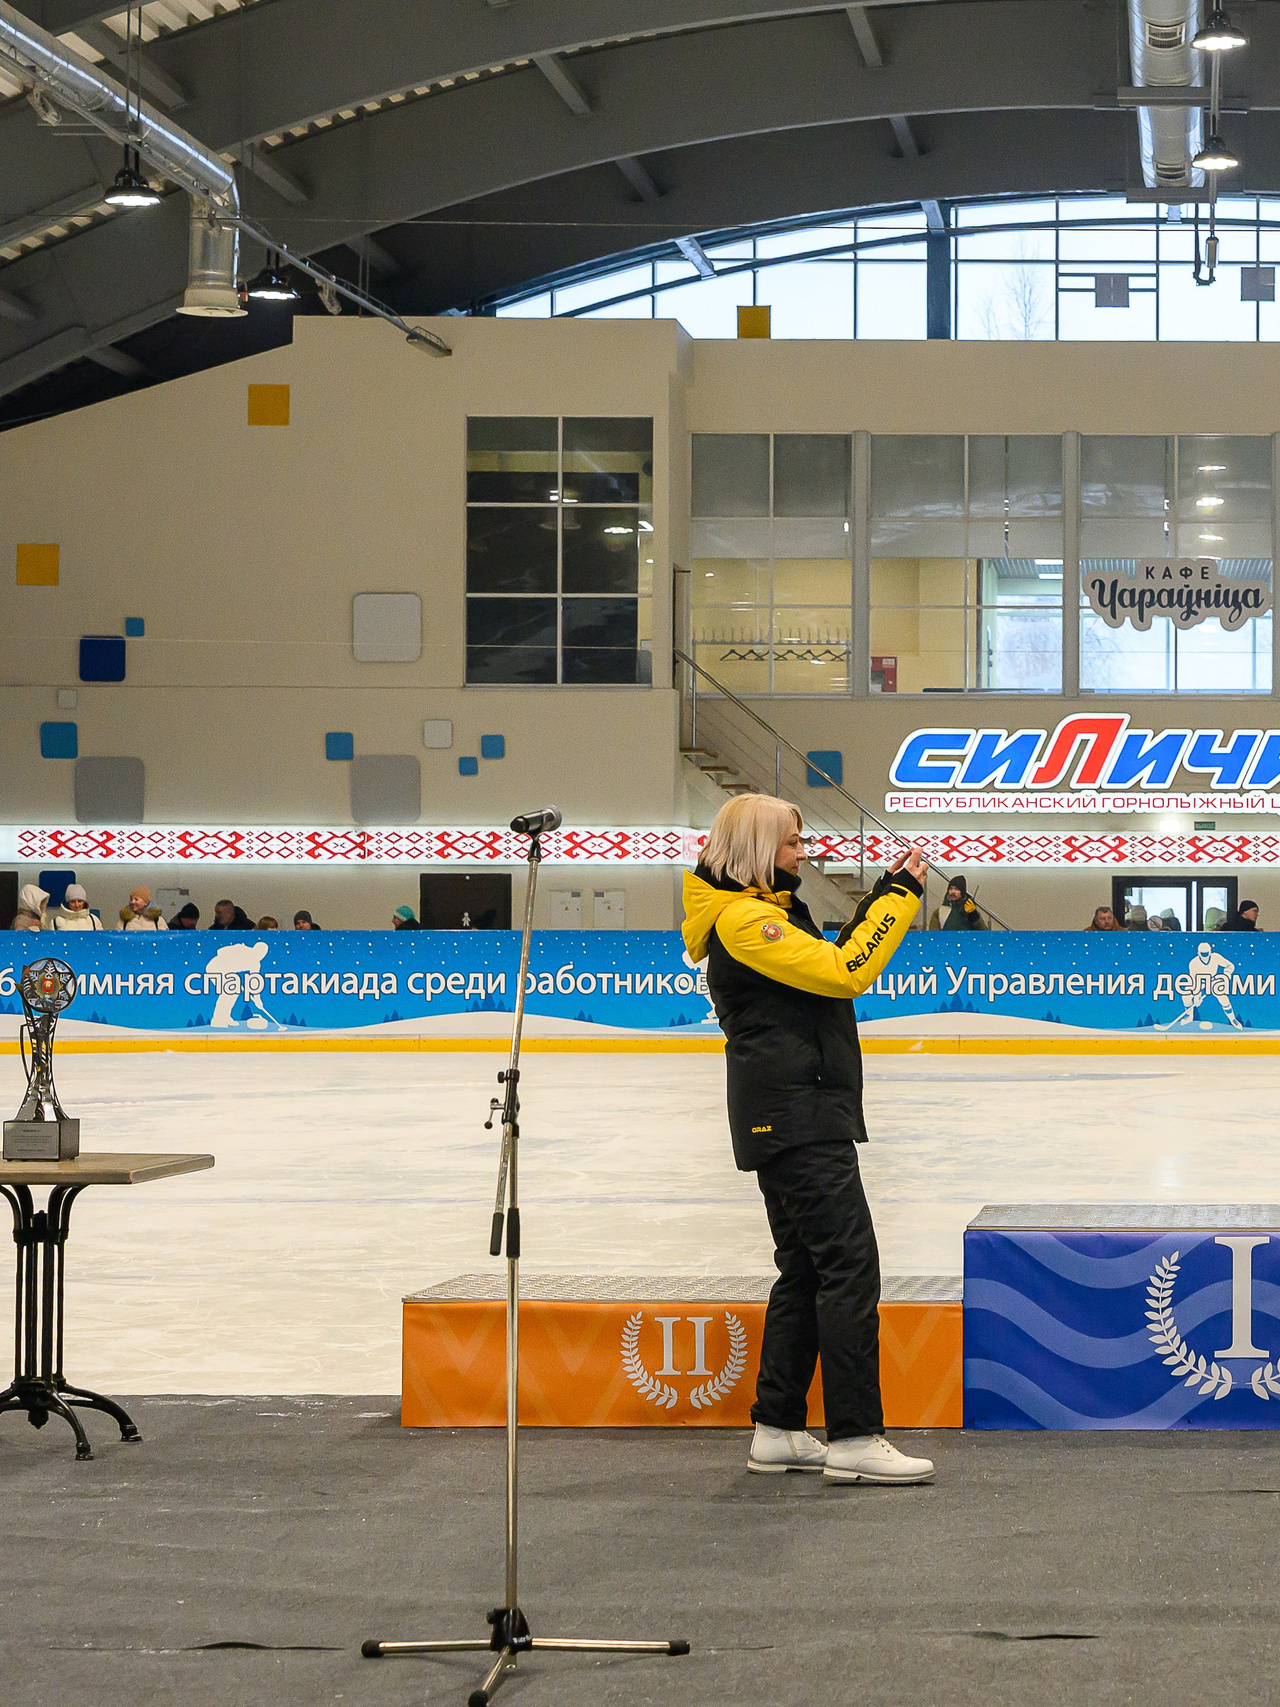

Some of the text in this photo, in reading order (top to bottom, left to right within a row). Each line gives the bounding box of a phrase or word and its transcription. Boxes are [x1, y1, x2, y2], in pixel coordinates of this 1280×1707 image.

[1145, 566, 1210, 580] КАФЕ
[889, 794, 1097, 809] РЕСПУБЛИКАНСКИЙ
[1102, 794, 1265, 809] ГОРНОЛЫЖНЫЙ
[845, 912, 897, 973] BELARUS
[77, 972, 174, 996] имняя
[184, 972, 398, 1002] спартакиада
[406, 972, 506, 1002] среди
[946, 966, 1144, 1003] Управления
[1153, 971, 1275, 1001] делами
[653, 1316, 714, 1376] II
